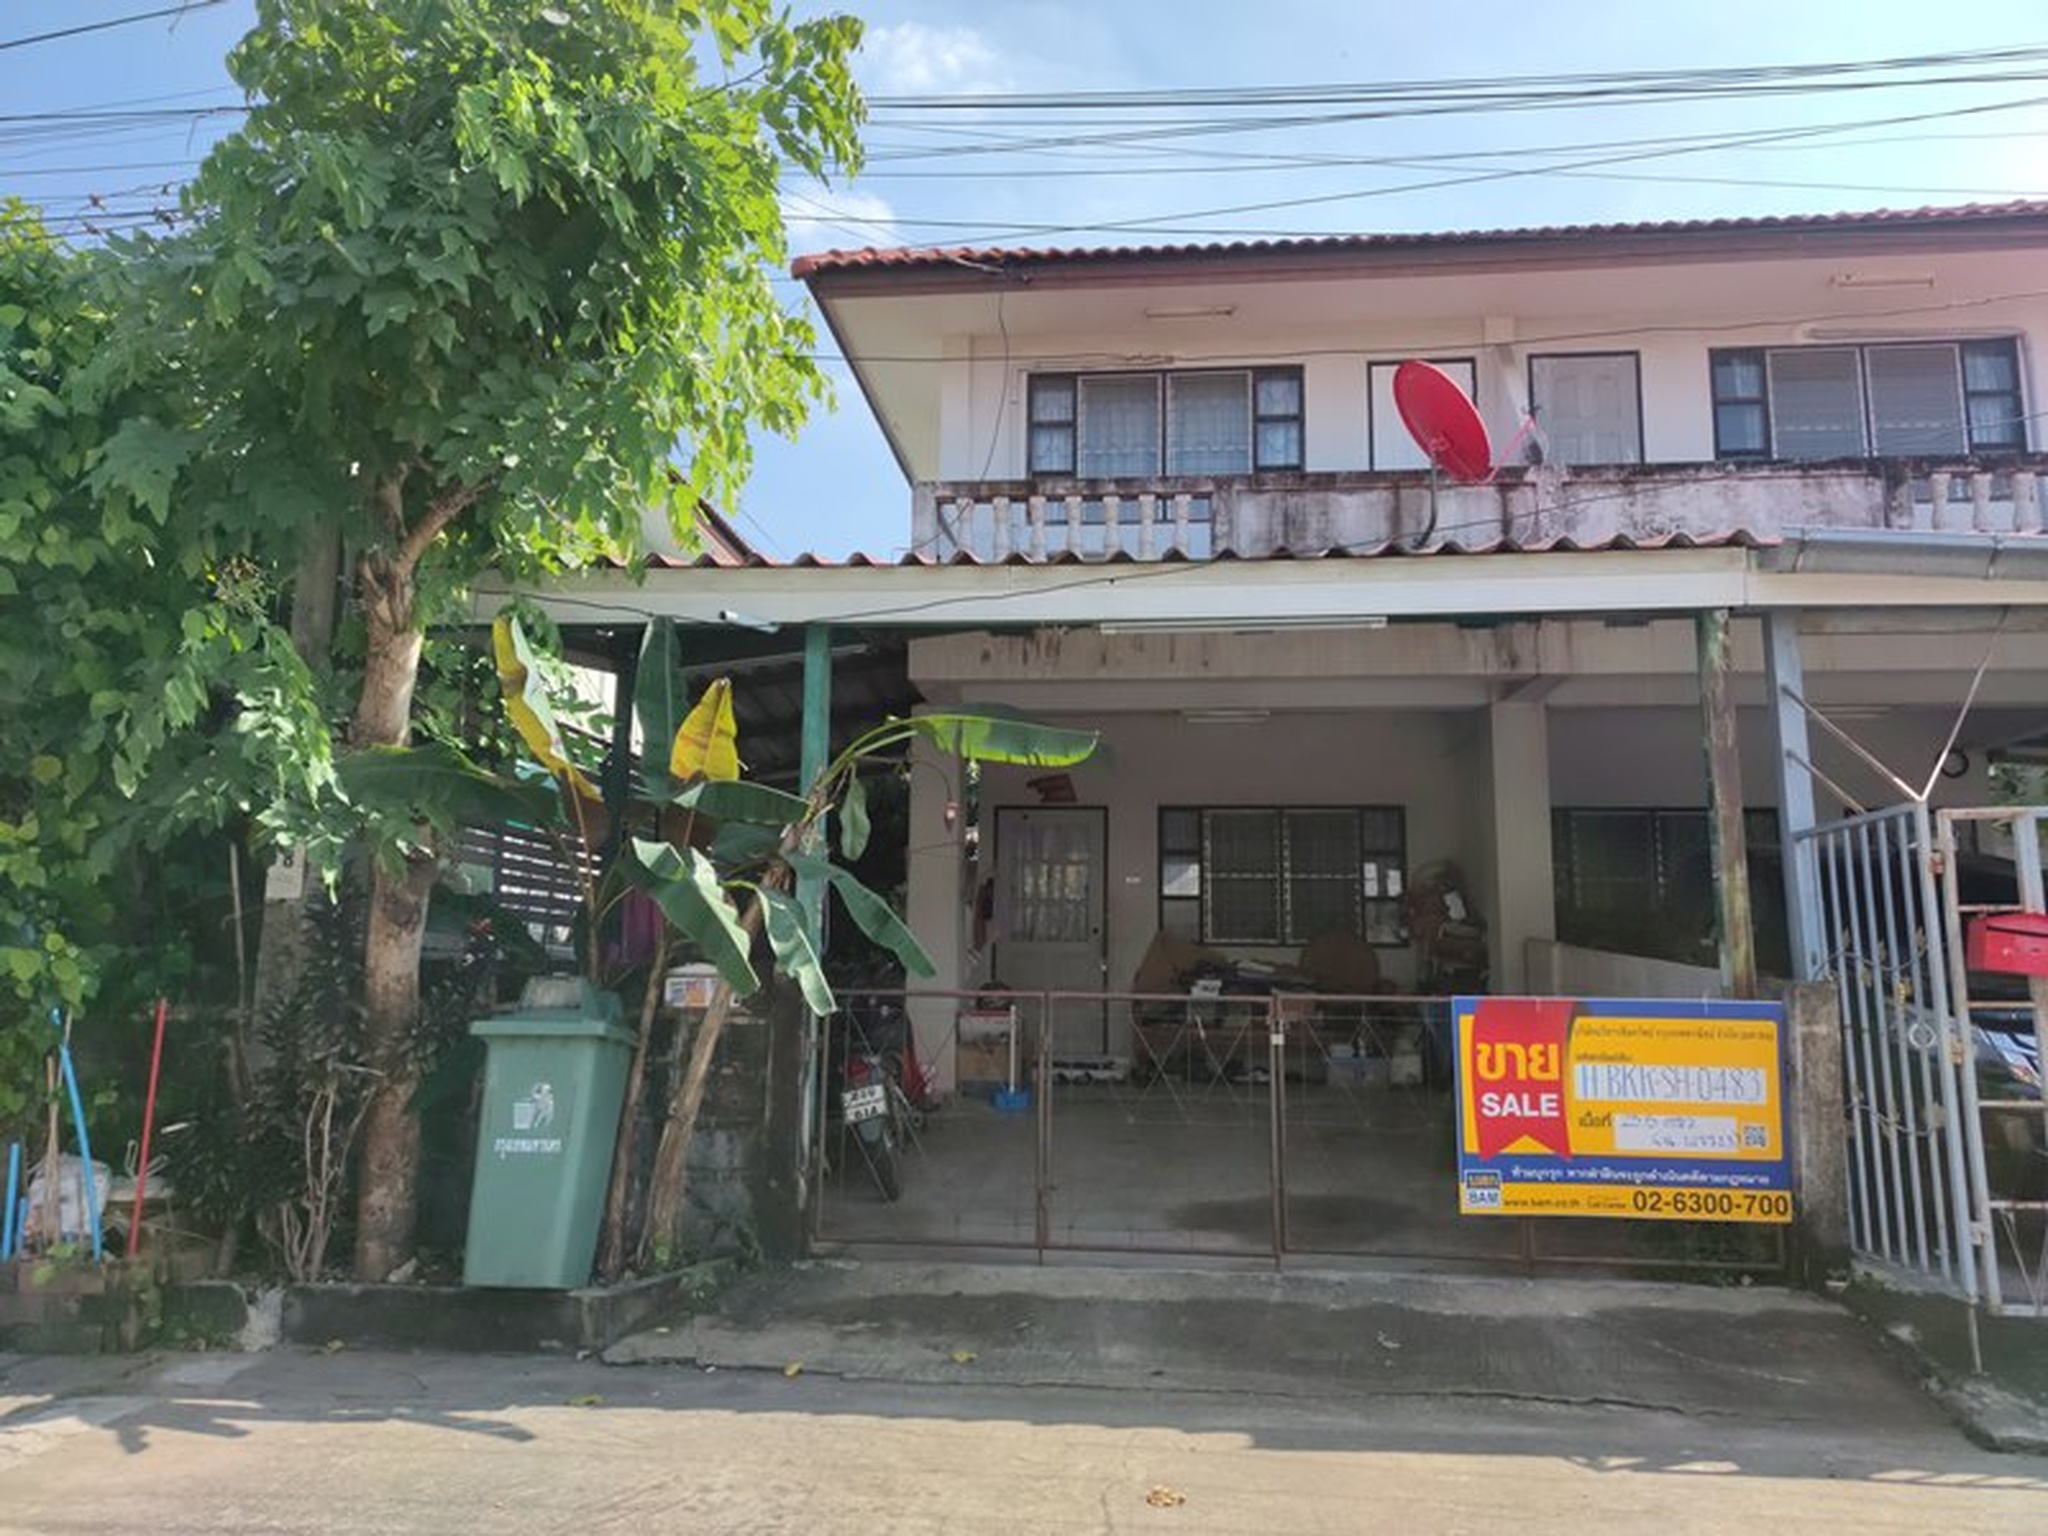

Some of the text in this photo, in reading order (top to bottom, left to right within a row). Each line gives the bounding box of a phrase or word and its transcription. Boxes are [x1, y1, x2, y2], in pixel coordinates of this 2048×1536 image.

[1477, 1043, 1559, 1081] ขาย
[1481, 1092, 1560, 1118] SALE
[1632, 1190, 1789, 1216] 02-6300-700
